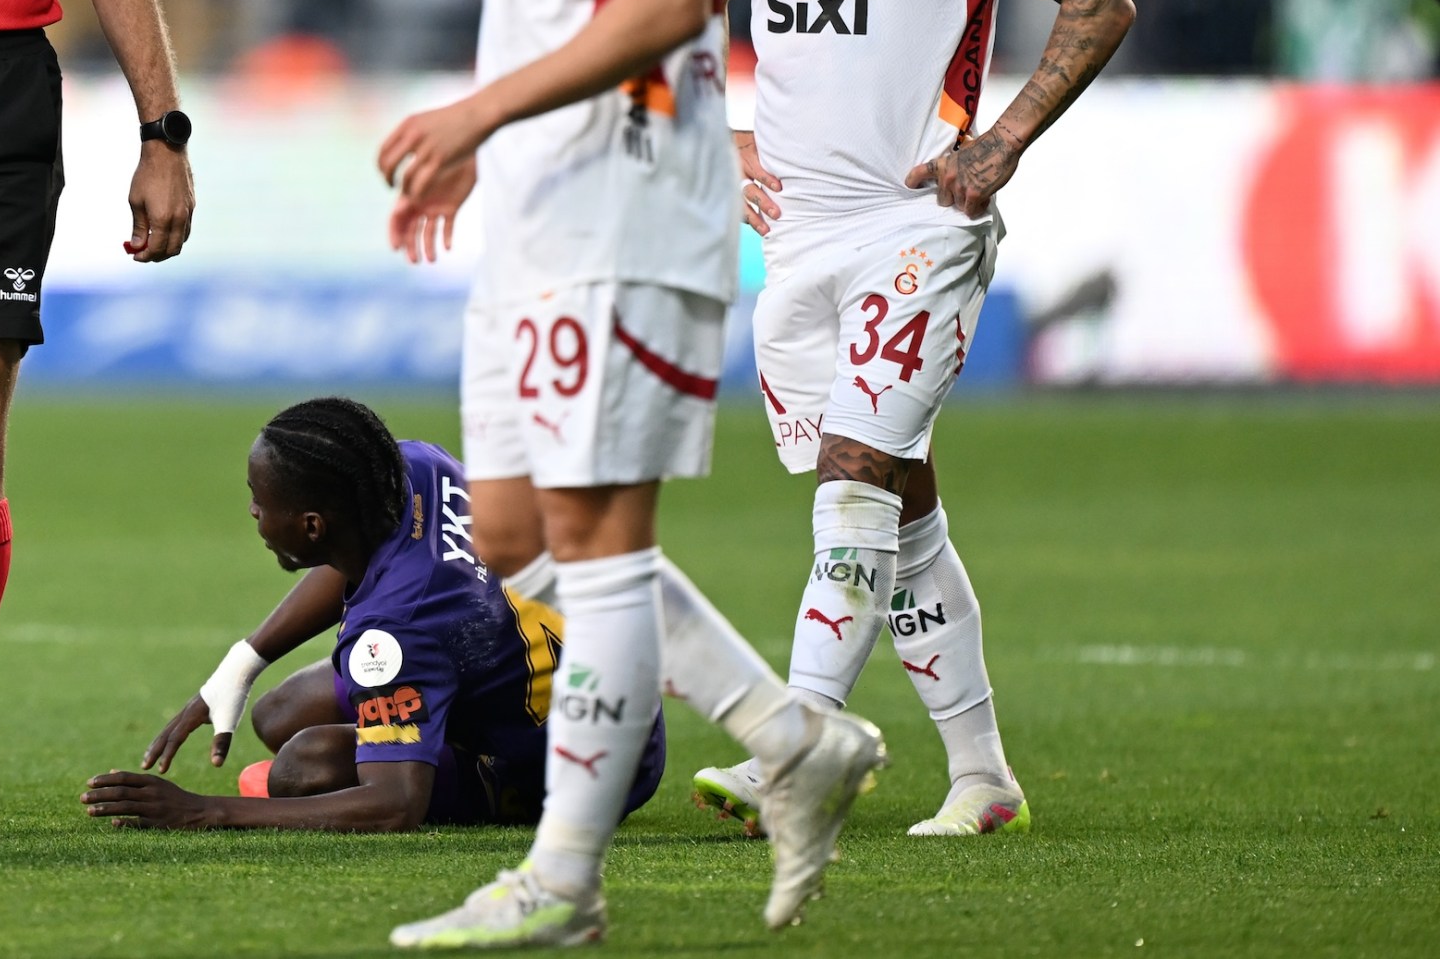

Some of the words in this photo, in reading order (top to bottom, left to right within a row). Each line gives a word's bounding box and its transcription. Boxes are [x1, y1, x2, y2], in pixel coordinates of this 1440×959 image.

[0, 289, 37, 302] hummel
[515, 315, 589, 398] 29
[850, 294, 931, 383] 34
[776, 413, 823, 447] PAY
[442, 476, 475, 565] YKT
